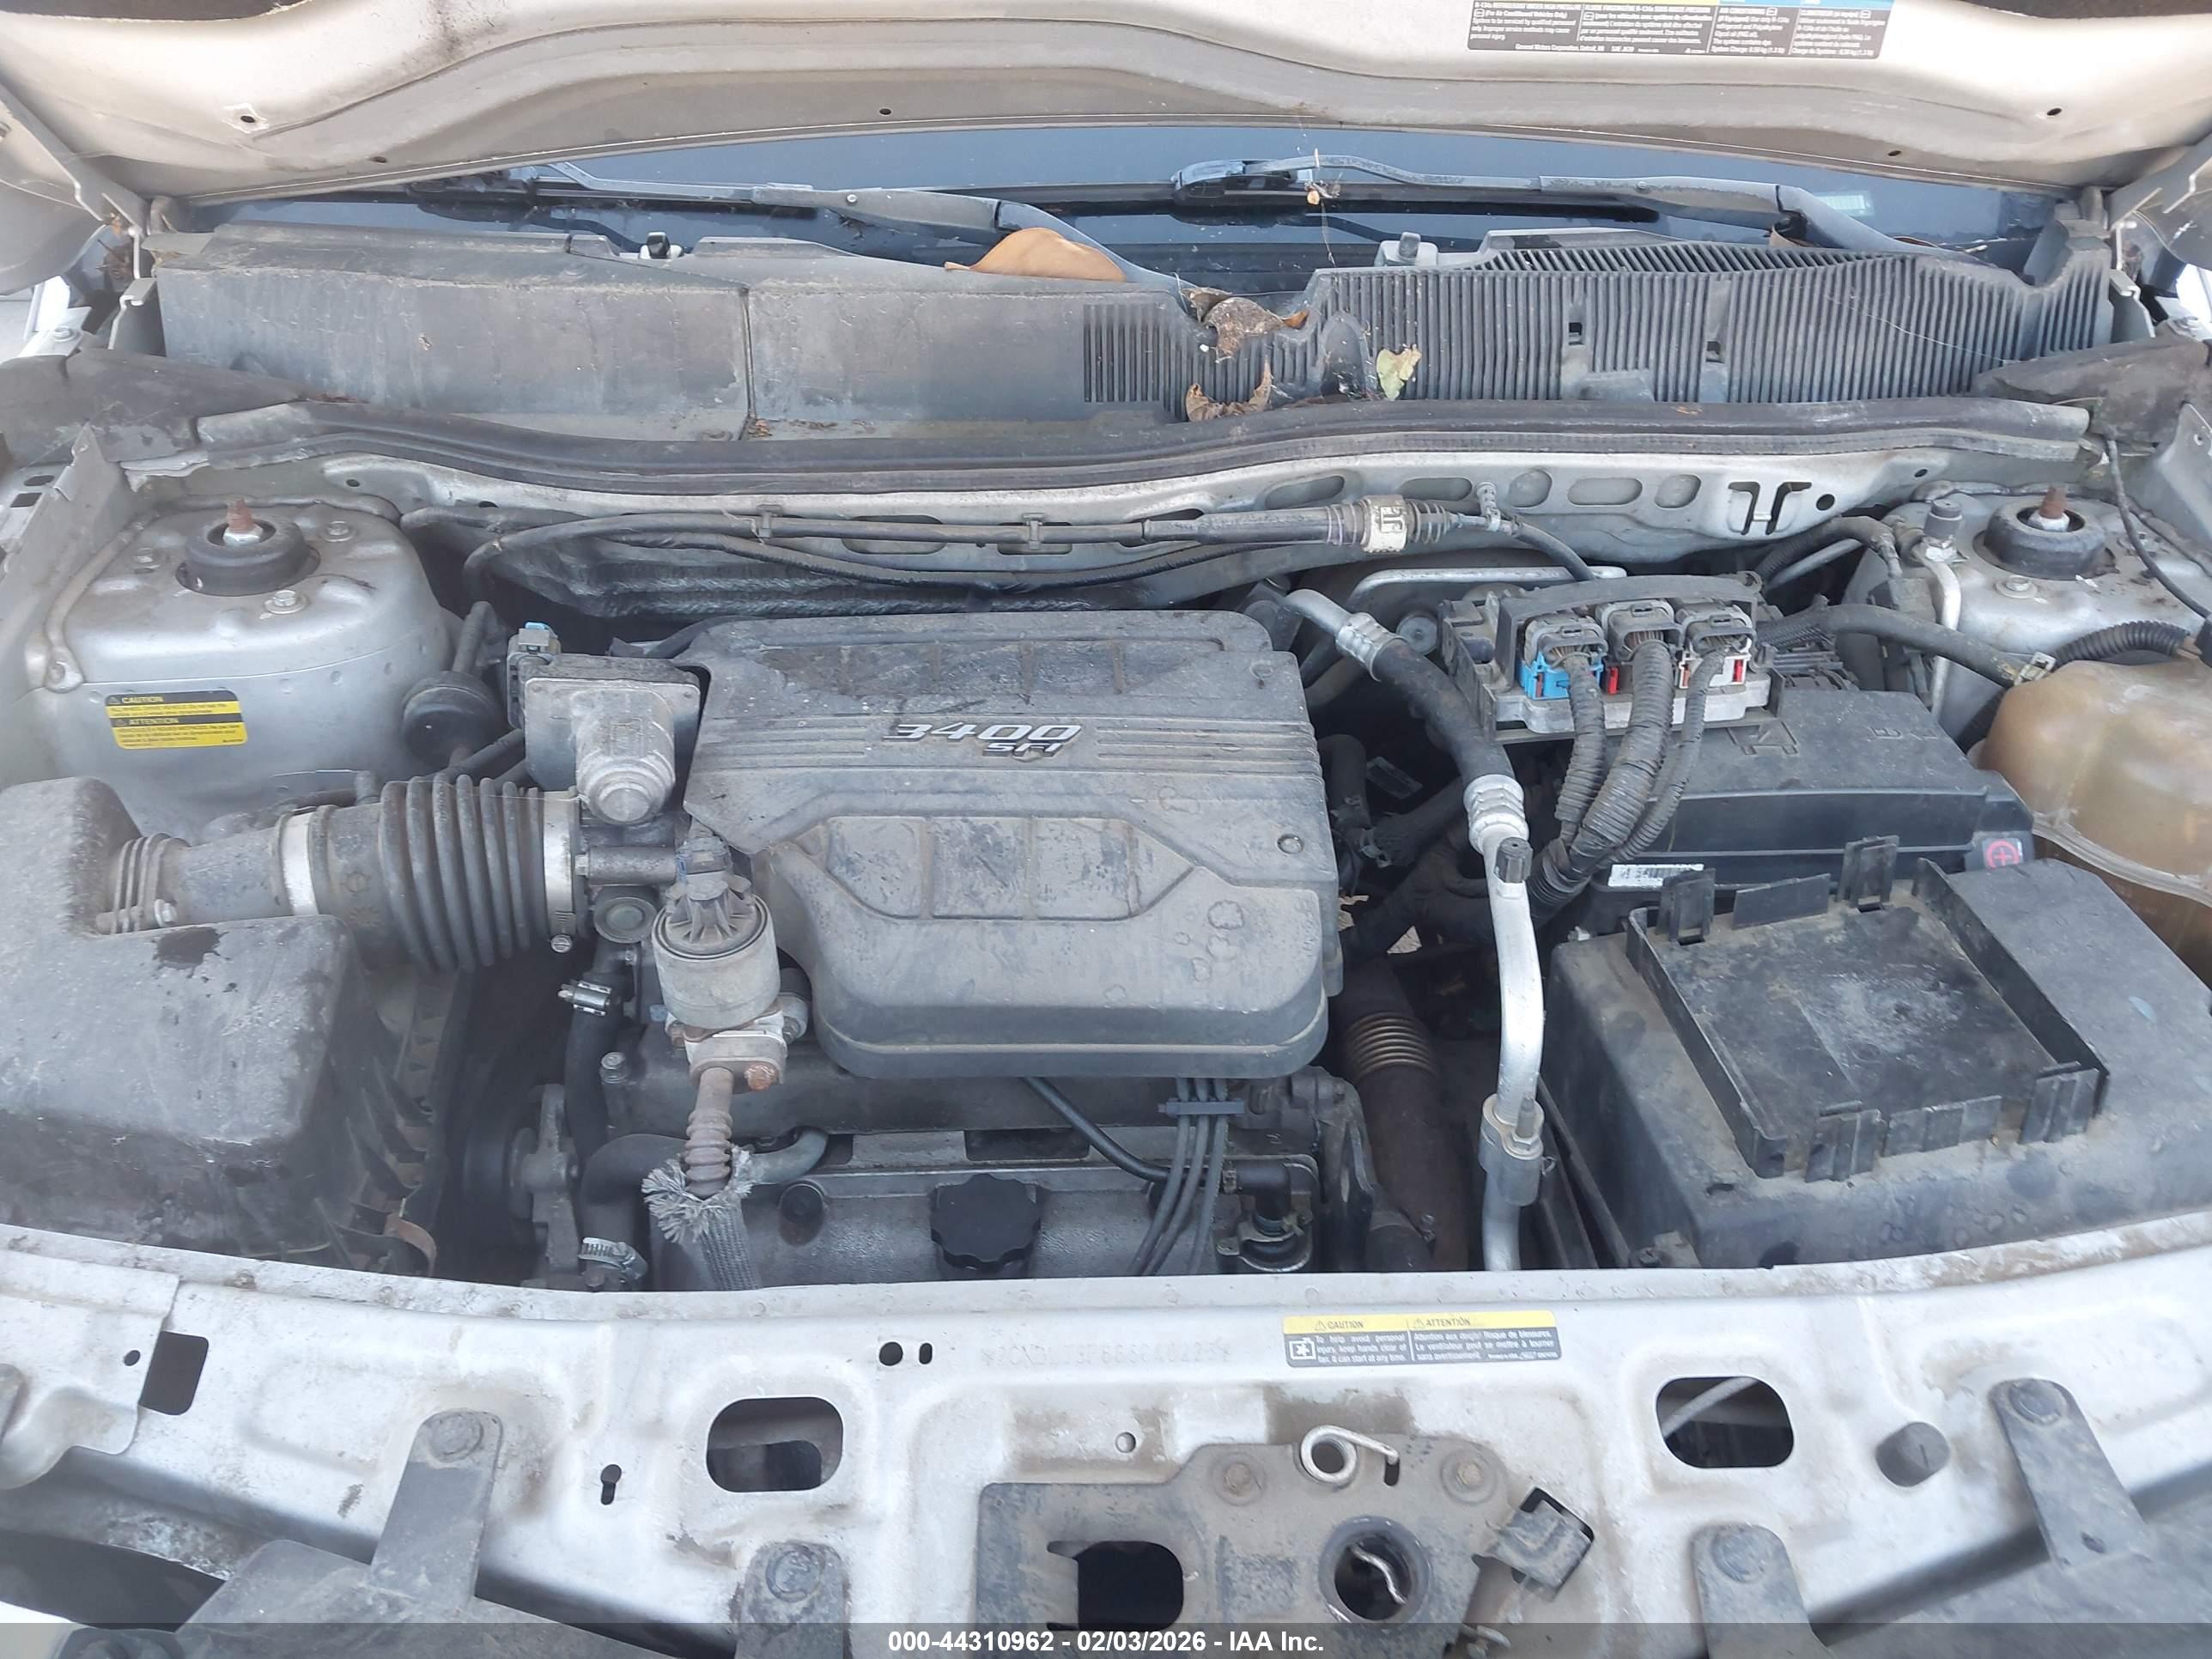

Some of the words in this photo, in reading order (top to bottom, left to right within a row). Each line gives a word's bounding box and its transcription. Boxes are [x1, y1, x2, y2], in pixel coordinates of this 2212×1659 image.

[122, 696, 163, 704] CAUTION
[882, 721, 1081, 742] 3400
[982, 742, 1064, 757] SFI
[1328, 1321, 1364, 1329] CAUTION
[1425, 1317, 1471, 1327] ATTENTION
